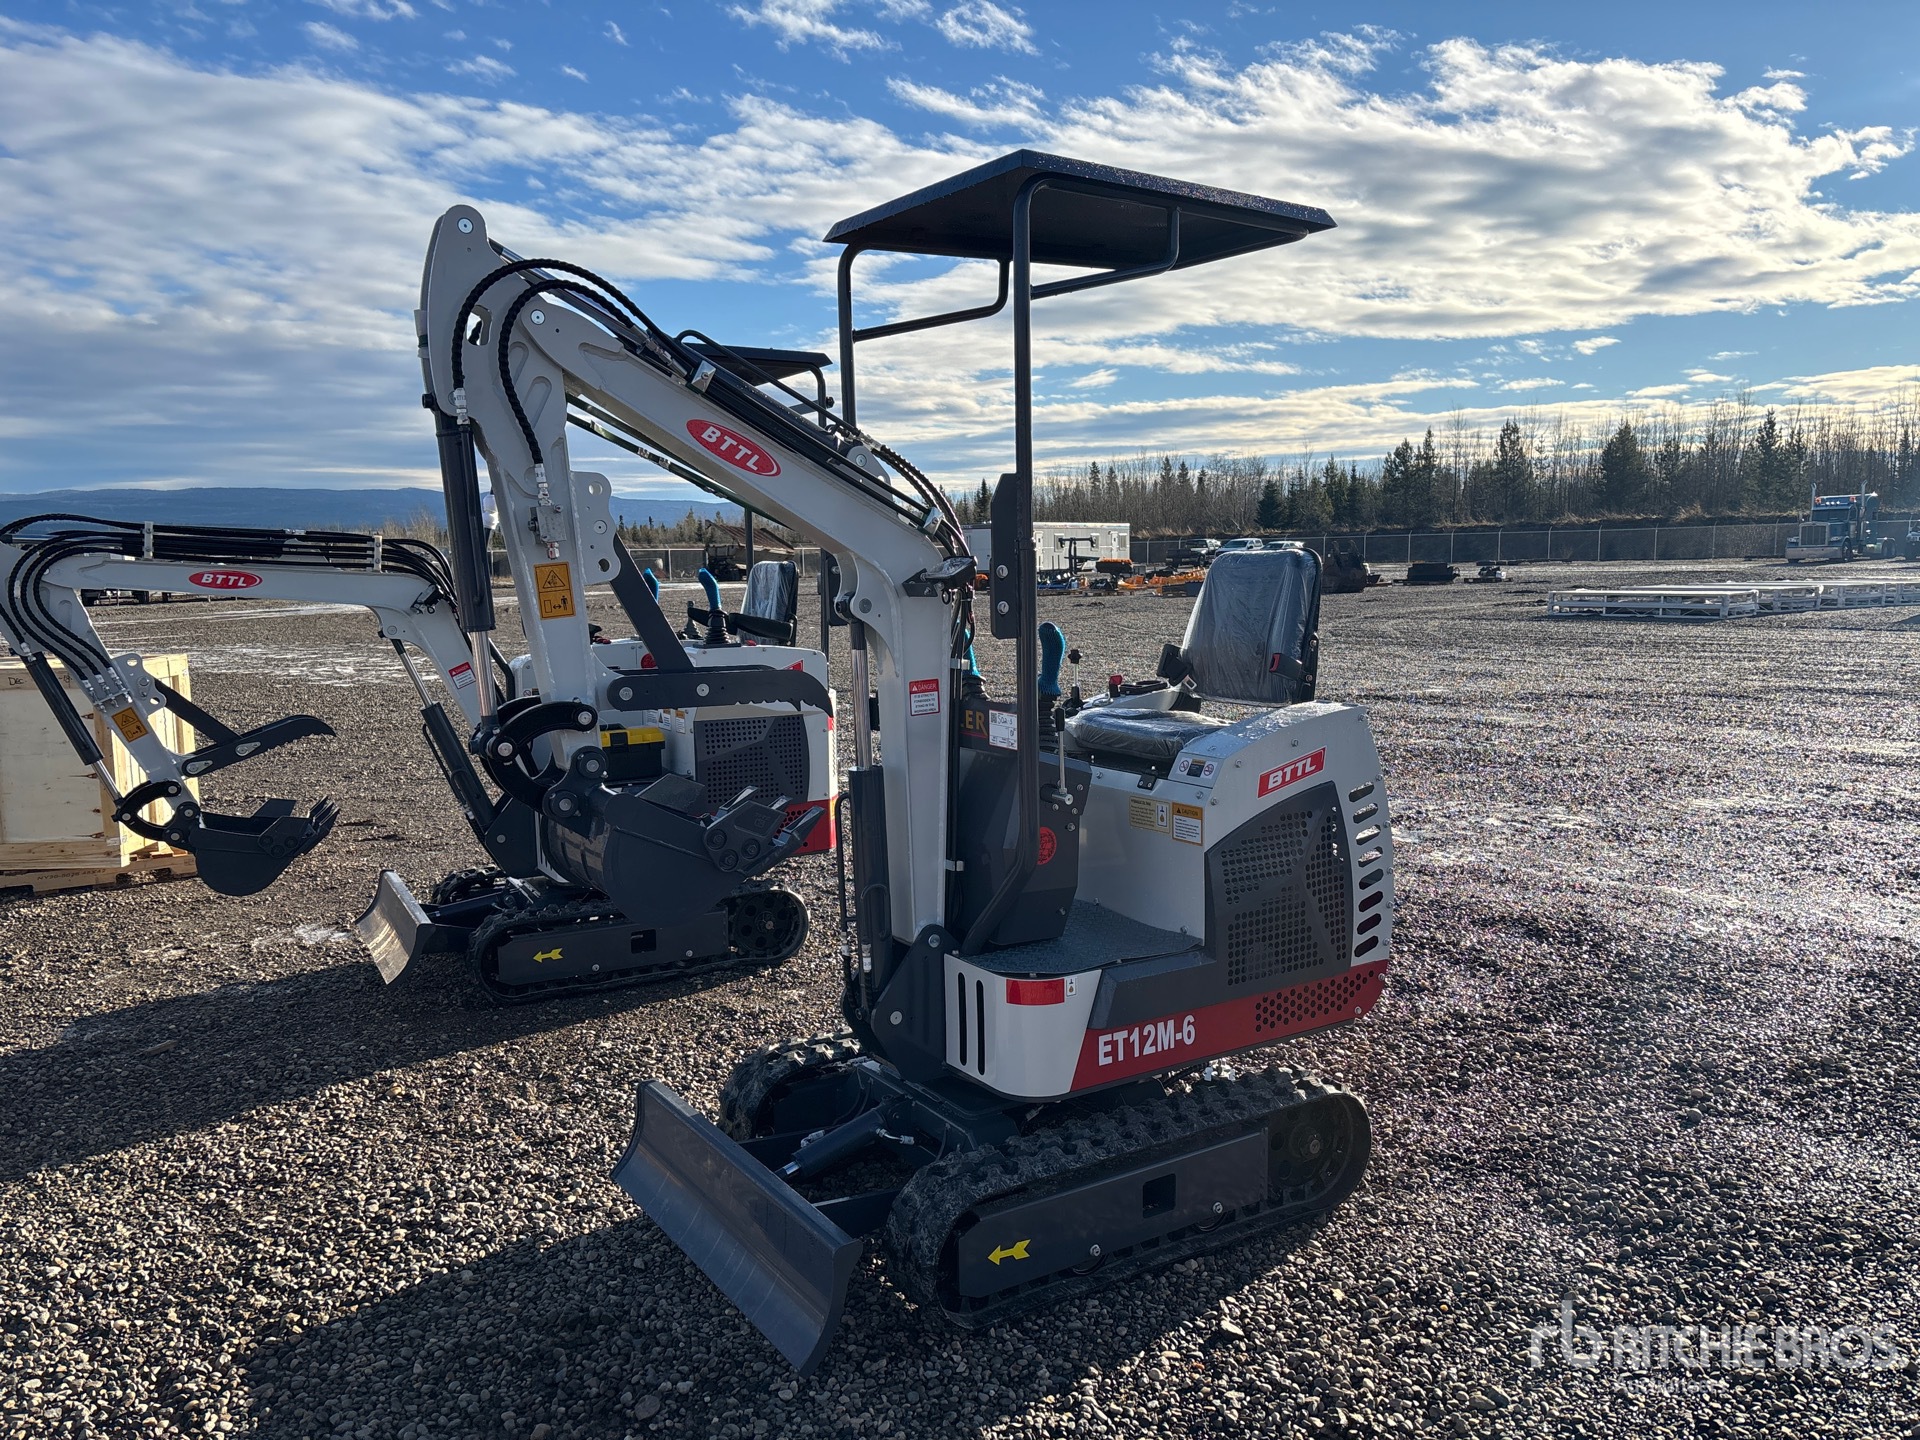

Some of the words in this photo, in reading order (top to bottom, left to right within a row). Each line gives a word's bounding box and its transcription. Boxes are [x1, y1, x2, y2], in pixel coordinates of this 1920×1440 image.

[701, 426, 759, 471] BTTL
[201, 573, 247, 587] BTTL
[917, 683, 937, 691] DANGER
[960, 709, 988, 737] ER
[1267, 757, 1317, 790] BTTL
[1181, 808, 1199, 817] CAUTION
[1098, 1014, 1196, 1067] ET12M-6
